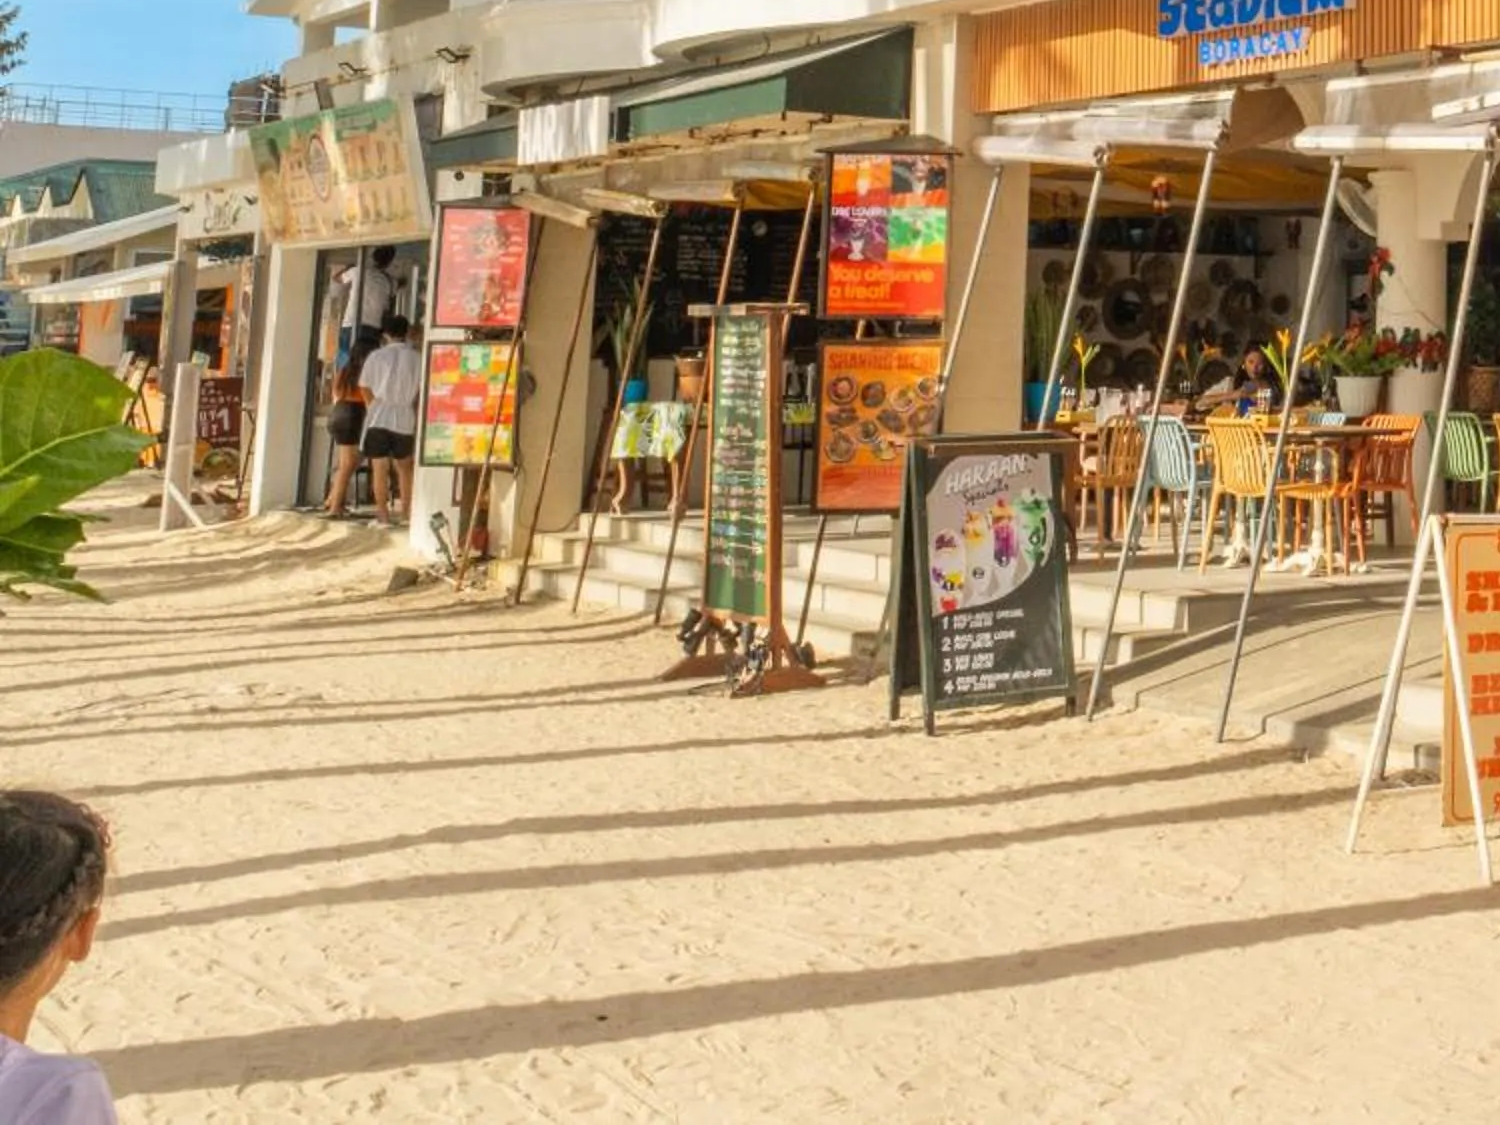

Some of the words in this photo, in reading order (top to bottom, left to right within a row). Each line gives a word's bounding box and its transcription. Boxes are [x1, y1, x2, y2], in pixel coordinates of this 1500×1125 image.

[1198, 27, 1307, 65] BORACAY
[830, 263, 861, 282] You
[864, 264, 935, 283] deserve
[829, 285, 842, 299] a
[944, 452, 1027, 494] HARAAN
[1466, 592, 1488, 613] &
